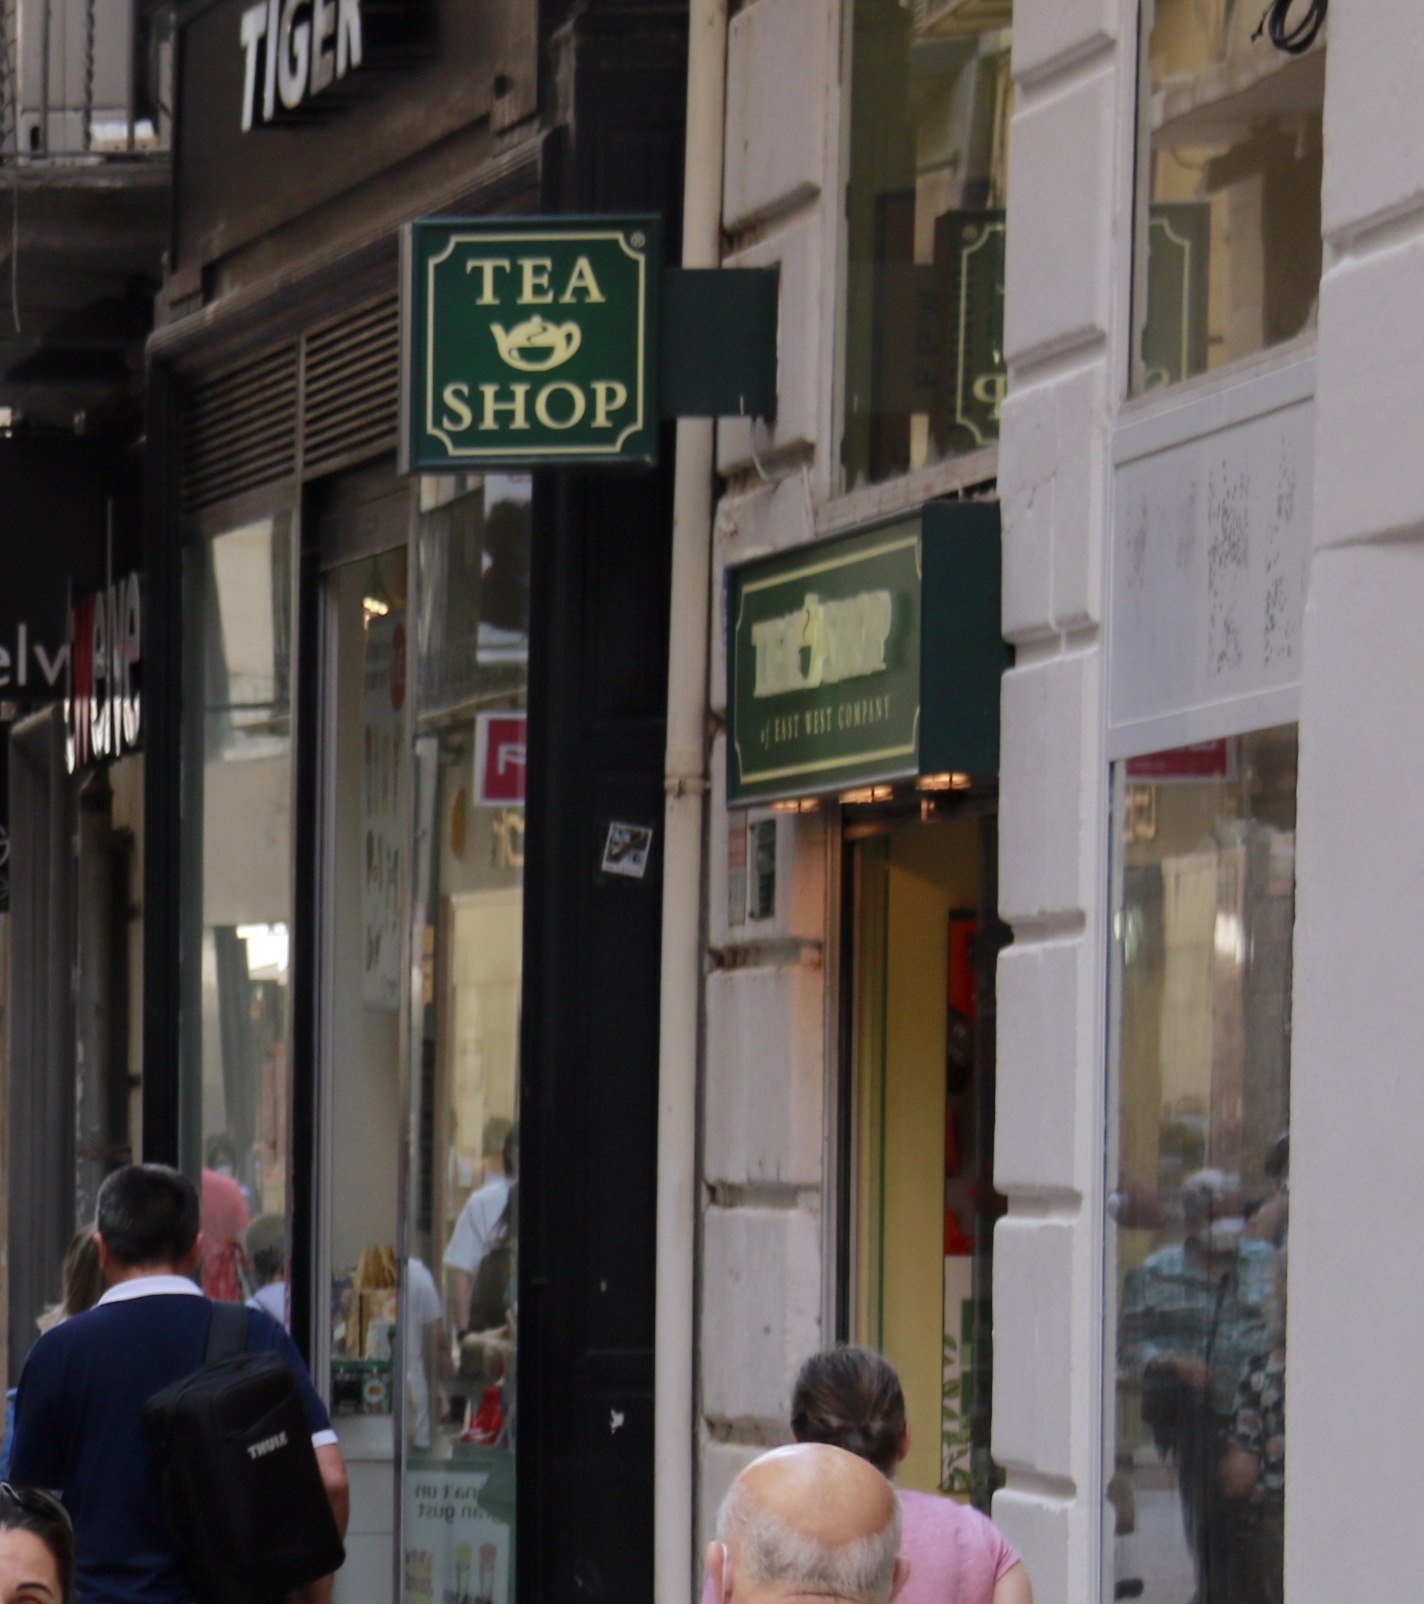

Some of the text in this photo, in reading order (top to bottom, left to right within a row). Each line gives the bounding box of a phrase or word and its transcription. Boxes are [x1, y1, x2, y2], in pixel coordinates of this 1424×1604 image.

[240, 0, 364, 132] TIGER
[465, 255, 606, 306] TEA
[442, 380, 628, 433] SHOP
[774, 713, 800, 744] EAST
[805, 705, 832, 736] WEST
[838, 696, 891, 731] COMPANY
[246, 1429, 289, 1461] THULE
